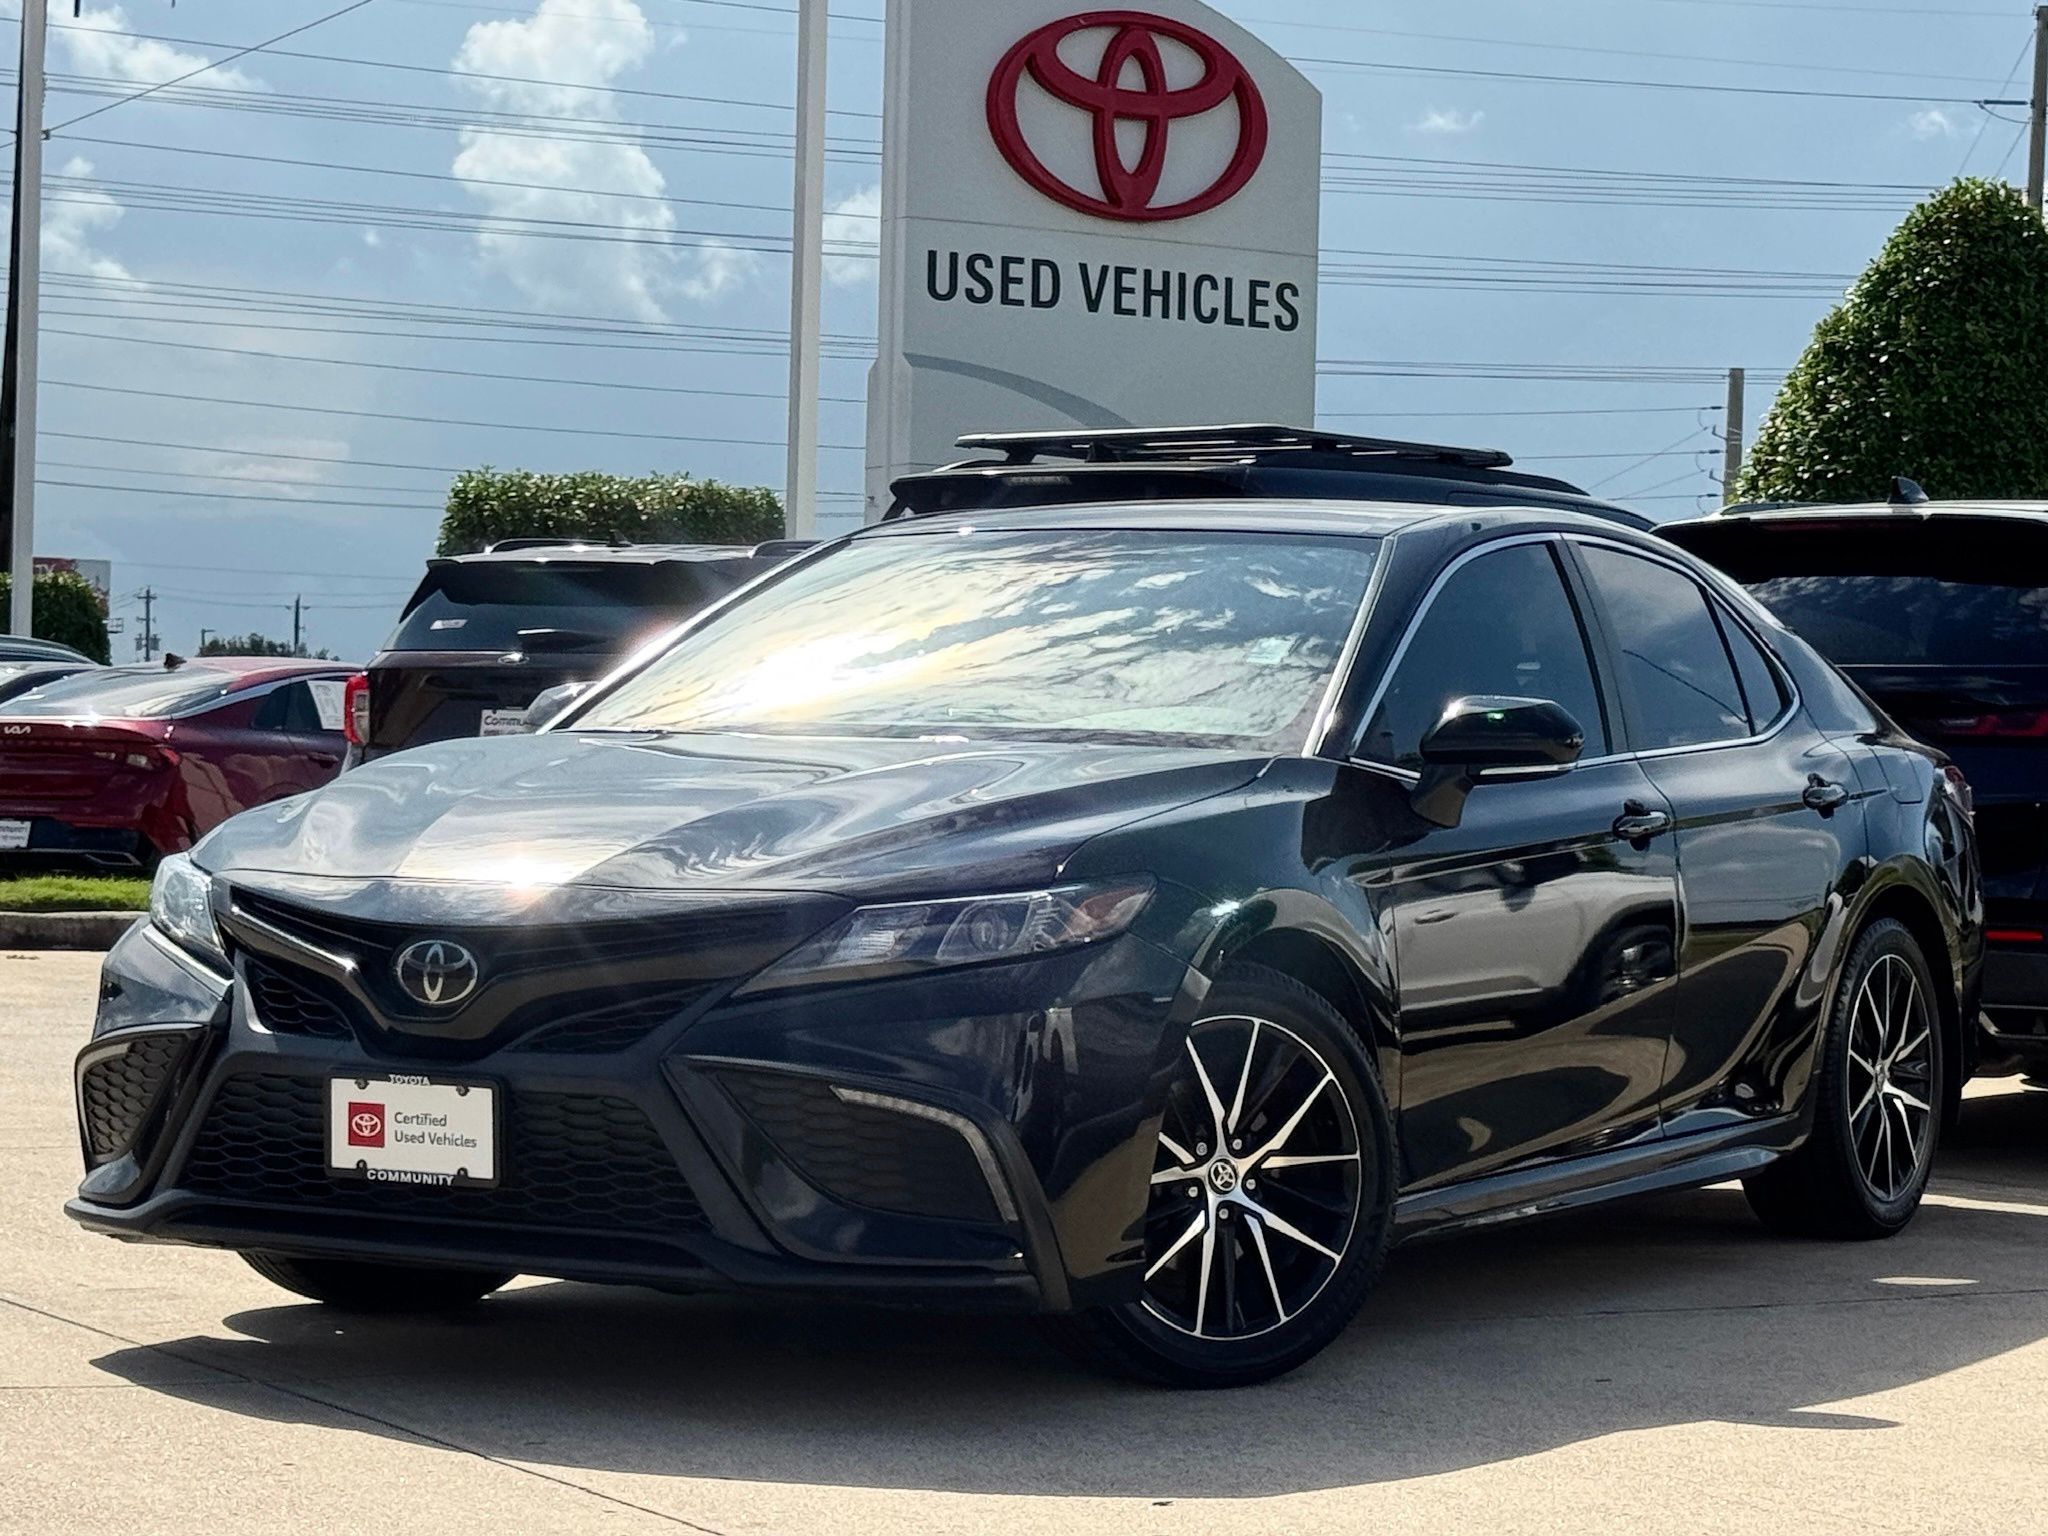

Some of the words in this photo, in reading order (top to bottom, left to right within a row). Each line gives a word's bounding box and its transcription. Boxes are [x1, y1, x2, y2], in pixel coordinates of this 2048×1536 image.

[927, 249, 1060, 309] USED
[1078, 262, 1300, 332] VEHICLES
[389, 1074, 431, 1086] TOYOTA
[394, 1112, 447, 1127] Certified
[394, 1130, 425, 1144] Used
[429, 1132, 477, 1148] Vehicles
[367, 1169, 455, 1186] COMMUNITY
